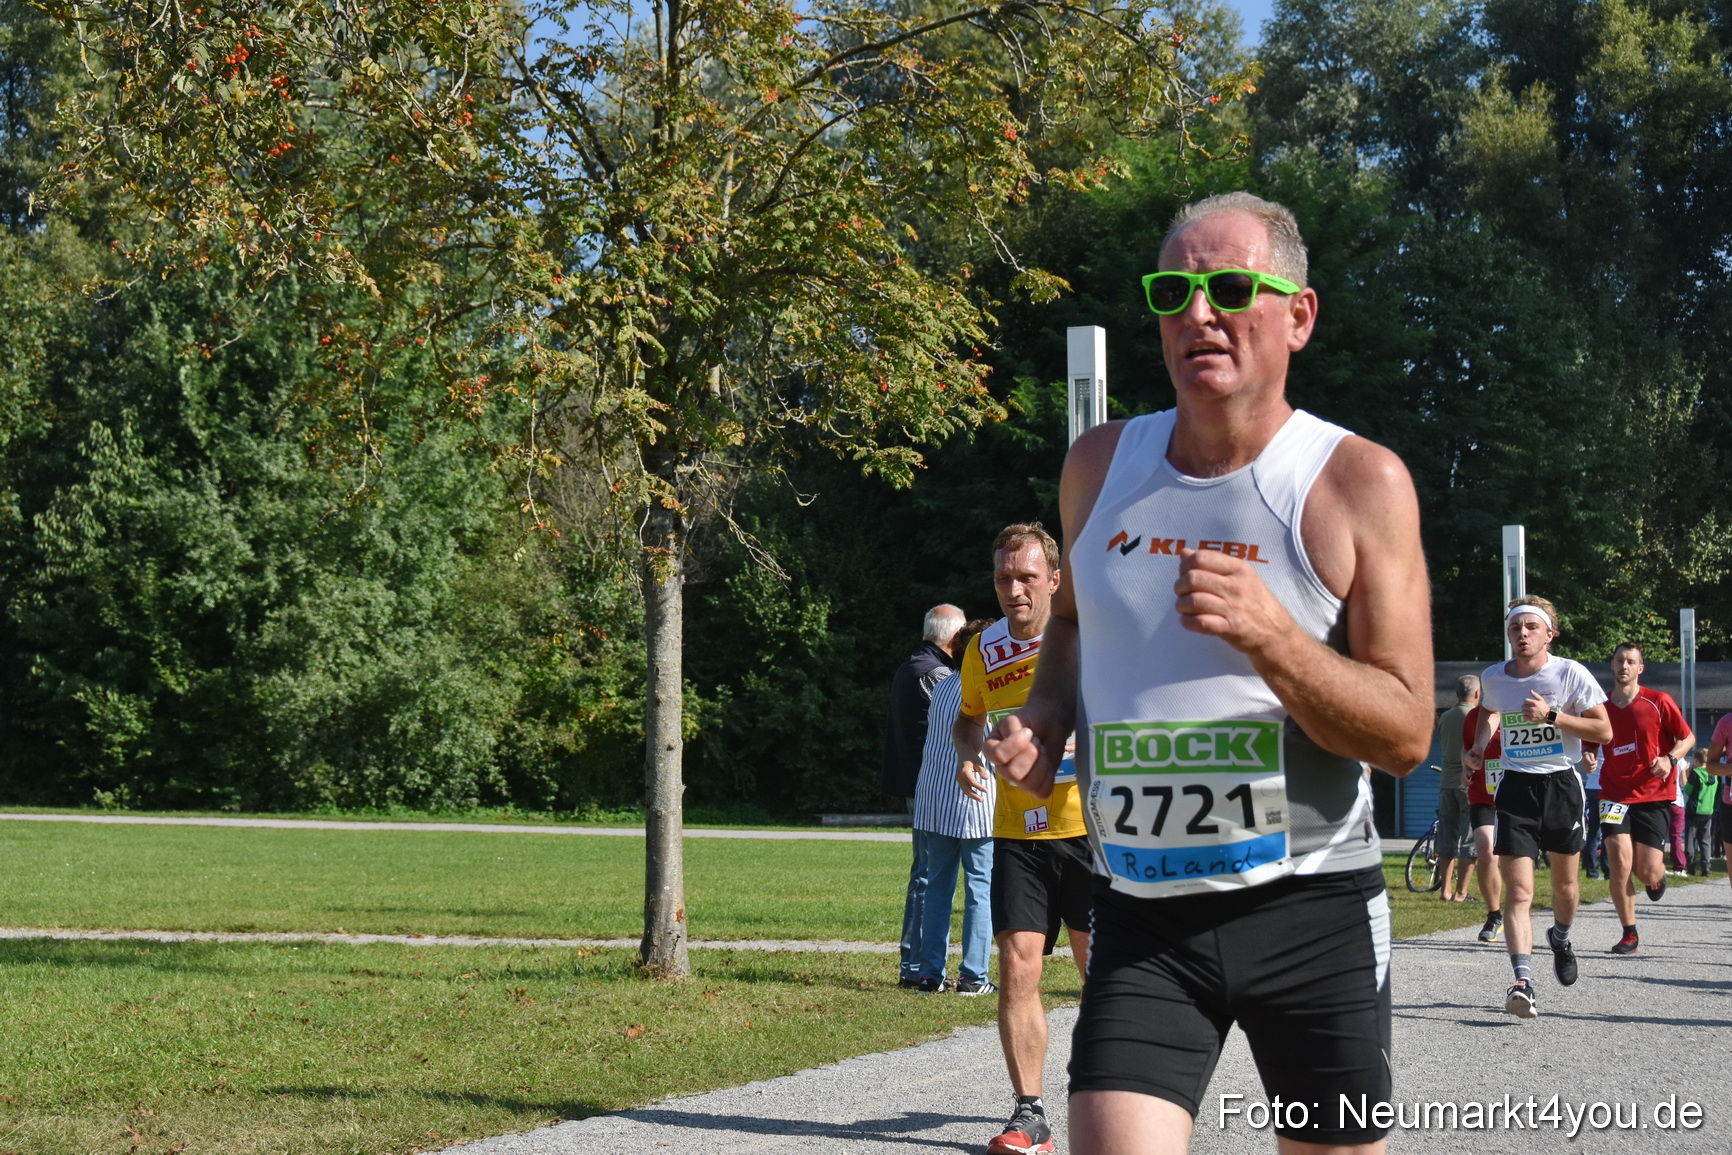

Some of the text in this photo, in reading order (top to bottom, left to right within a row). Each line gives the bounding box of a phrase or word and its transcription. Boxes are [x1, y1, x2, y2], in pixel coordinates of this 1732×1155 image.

[986, 664, 1031, 692] MAX
[1104, 727, 1264, 768] BOCK
[1509, 727, 1555, 746] 2250
[1514, 746, 1553, 758] THOMAS
[1110, 783, 1256, 837] 2721
